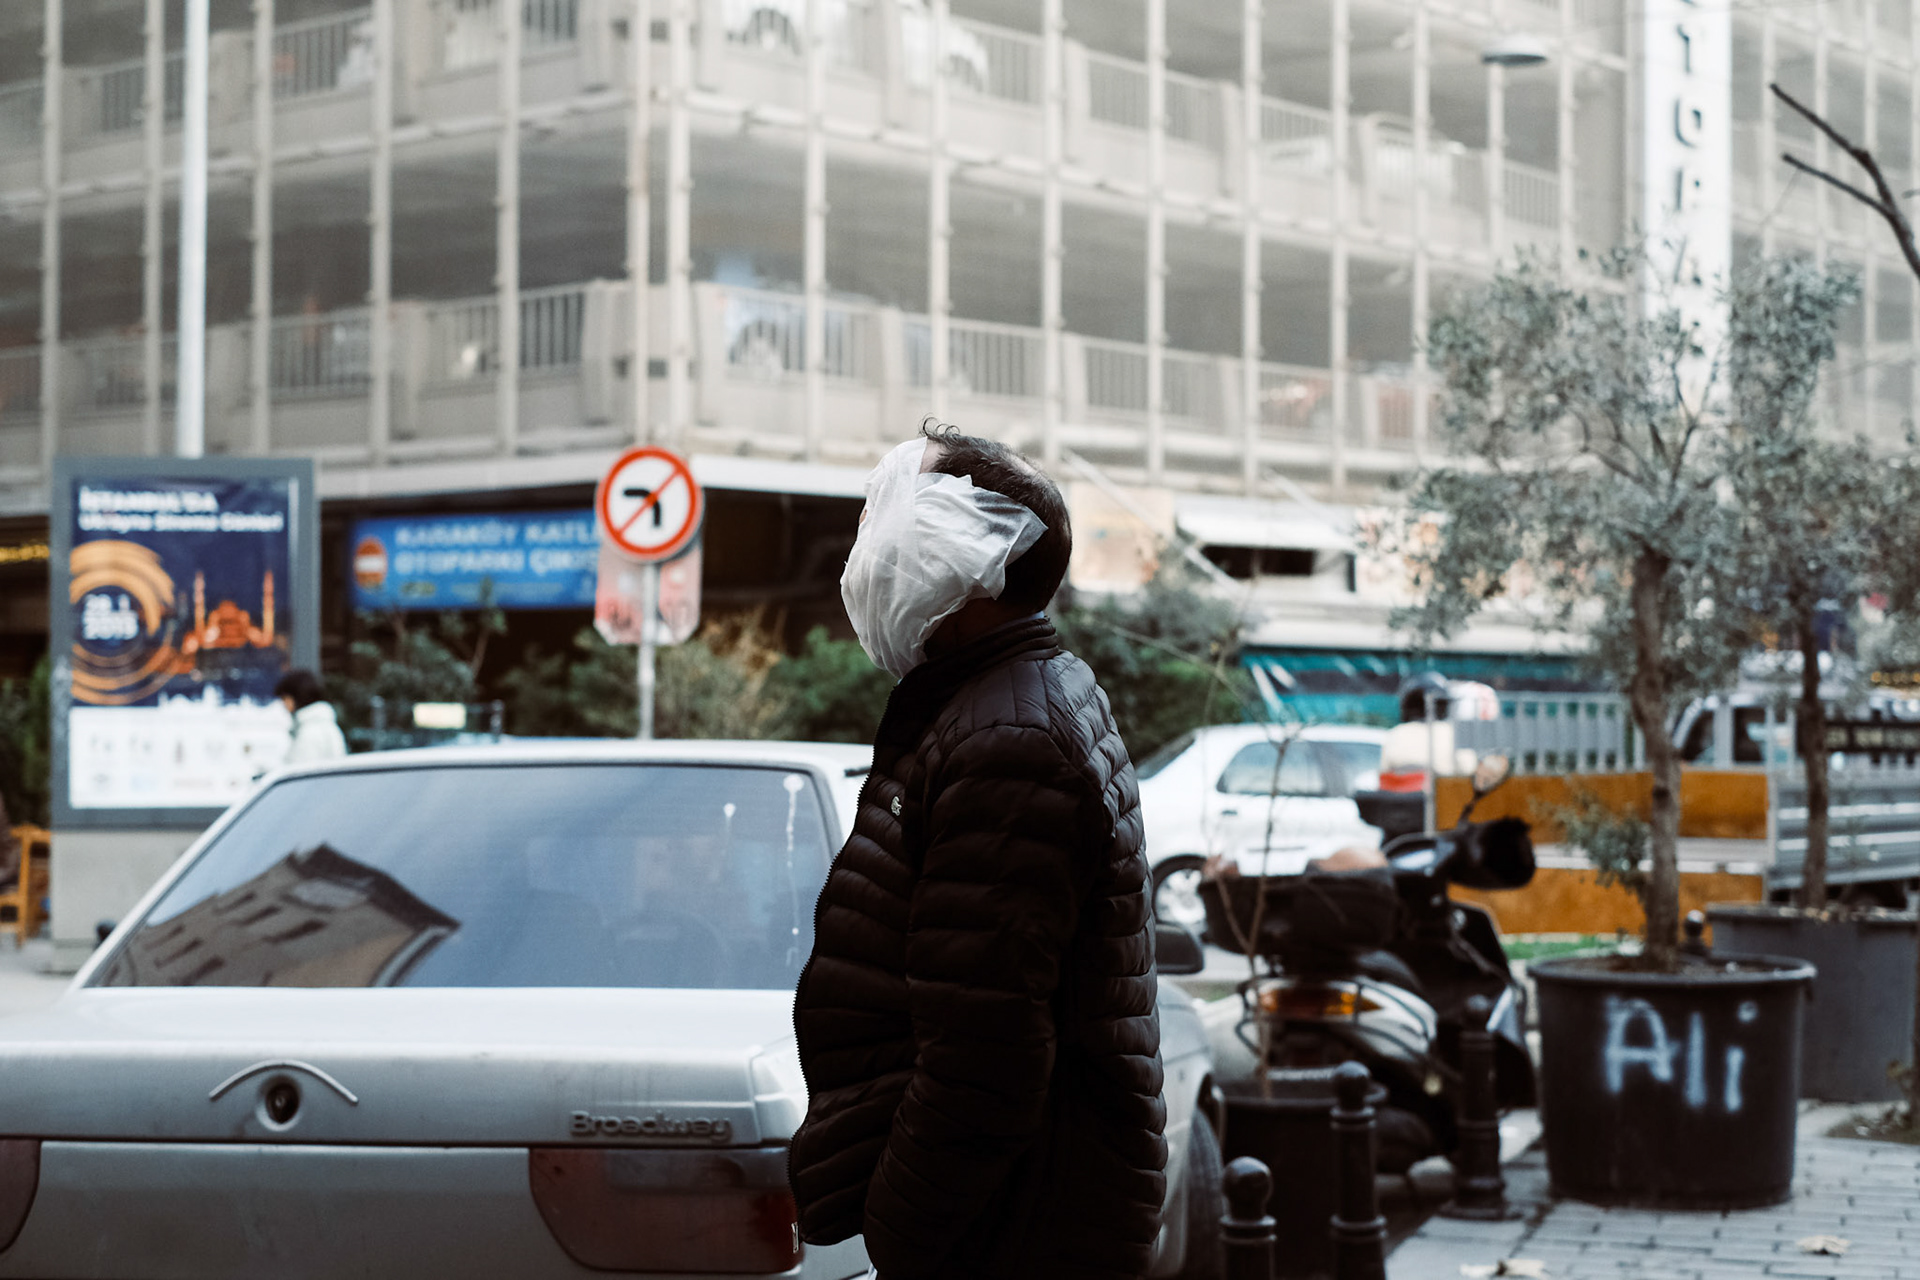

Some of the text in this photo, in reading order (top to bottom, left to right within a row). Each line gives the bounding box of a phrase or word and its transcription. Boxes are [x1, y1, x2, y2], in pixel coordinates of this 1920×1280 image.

[395, 520, 518, 547] KARAKÖY
[1604, 994, 1758, 1113] Ali
[569, 1109, 733, 1144] Broadway
